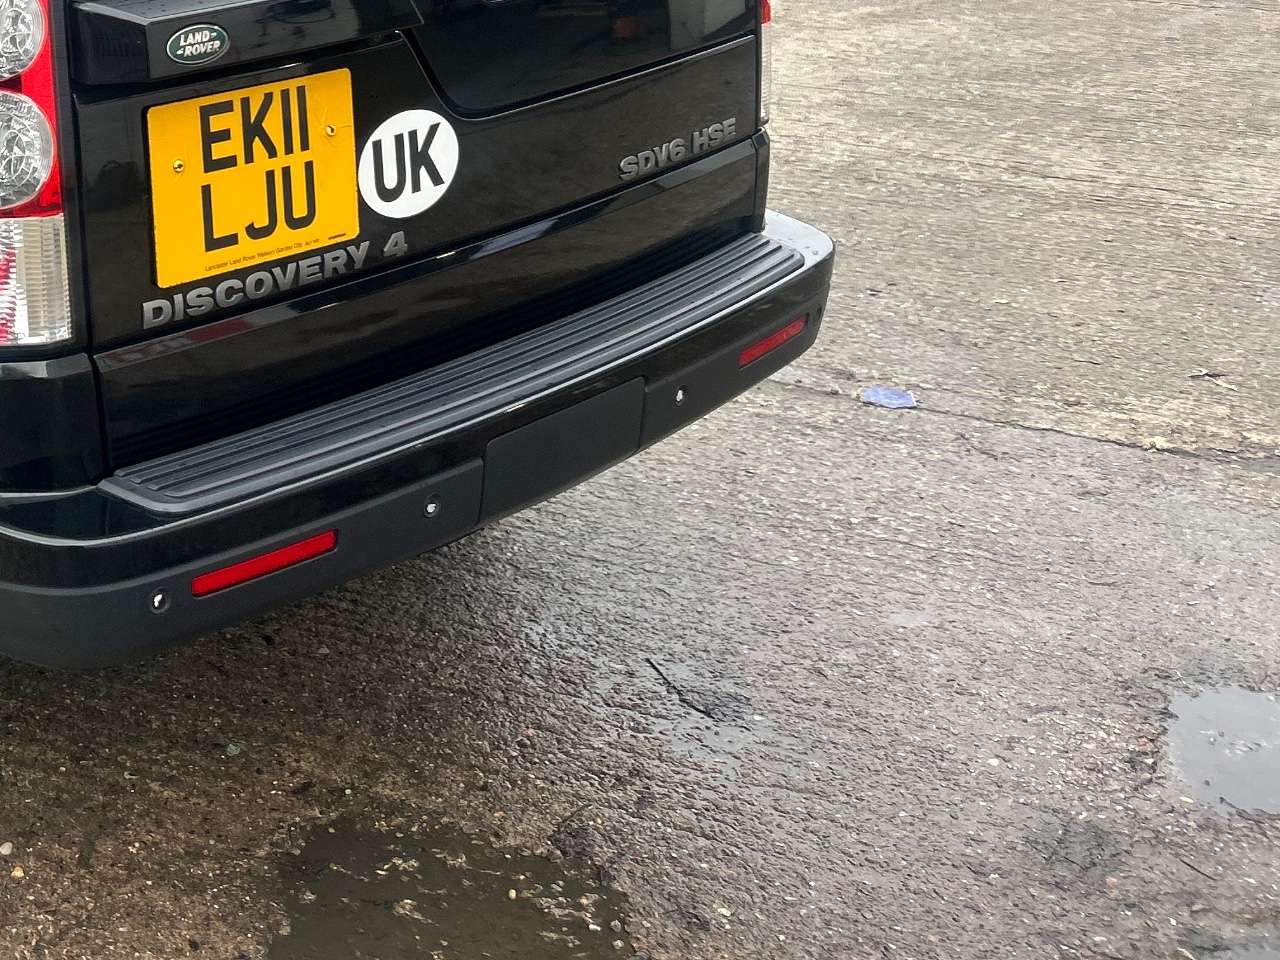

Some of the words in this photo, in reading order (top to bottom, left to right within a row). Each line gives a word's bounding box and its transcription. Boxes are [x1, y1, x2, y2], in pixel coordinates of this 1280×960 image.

[198, 85, 311, 174] EK11
[371, 121, 446, 203] UK
[619, 137, 687, 181] SDV6
[692, 116, 737, 155] HSE
[200, 160, 317, 253] LJU
[141, 240, 370, 330] DISCOVERY
[382, 230, 409, 259] 4
